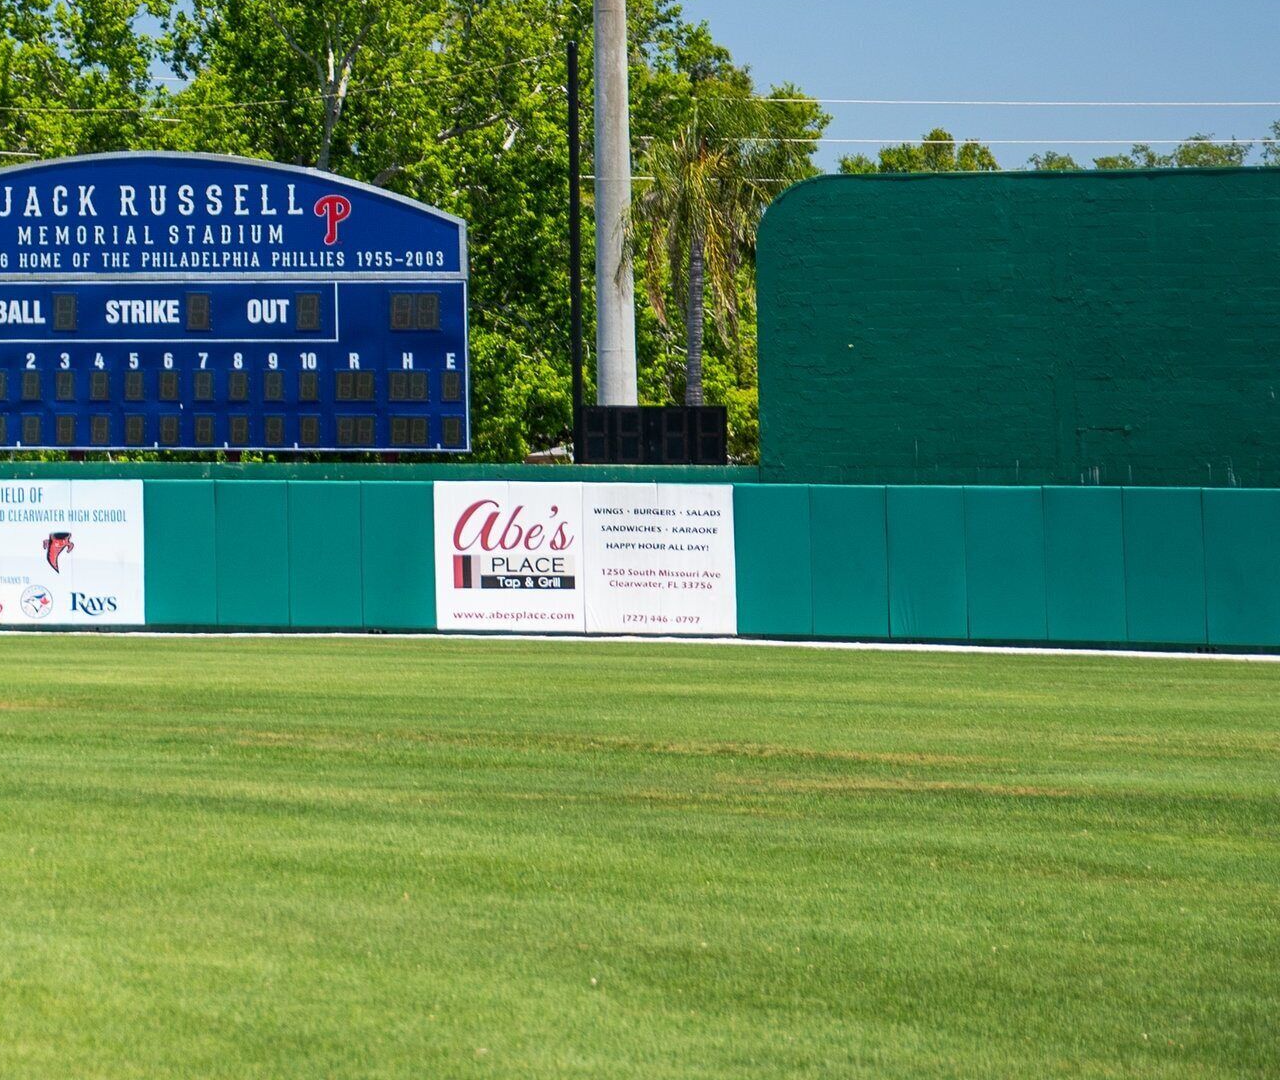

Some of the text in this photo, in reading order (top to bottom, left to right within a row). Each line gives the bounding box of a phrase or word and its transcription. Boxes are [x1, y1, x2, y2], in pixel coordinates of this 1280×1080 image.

[120, 184, 303, 217] RUSSELL
[314, 194, 351, 245] P
[17, 224, 284, 246] MEMORIAL STADIUM
[19, 252, 61, 268] HOME
[72, 252, 91, 268] OF
[102, 252, 130, 268] THE
[142, 251, 260, 267] PHILADELPHIA
[271, 251, 345, 267] PHILLIES
[356, 250, 444, 267] 1955-2003
[105, 299, 180, 324] STRIKE
[247, 299, 290, 324] OUT
[26, 352, 36, 369] 2
[60, 352, 70, 369] 3
[94, 352, 105, 369] 4
[129, 352, 139, 369] 5
[164, 352, 173, 369] 6
[198, 352, 208, 369] 7
[233, 352, 243, 369] 8
[268, 352, 278, 369] 9
[299, 352, 317, 369] 10
[349, 352, 360, 369] R
[402, 352, 413, 369] H
[446, 352, 456, 369] E
[29, 487, 44, 503] OF
[8, 509, 65, 522] CLEARWATER
[68, 509, 90, 522] HIGH
[92, 509, 126, 522] SCHOOL
[593, 507, 721, 517] WINGS BURGERS SALADS
[453, 499, 574, 552] Abe's
[601, 525, 718, 534] SANDWICHES KARAOKE
[606, 542, 709, 552] HAPPY HOUR ALL DAY!
[492, 557, 565, 573] PLACE
[601, 568, 721, 579] 1250 South Missouri Ave
[0, 576, 21, 585] THANKS
[496, 576, 561, 589] Tap & Grill
[609, 580, 713, 590] Clearwater, FL 33756
[453, 610, 575, 621] www.abesplace.com
[622, 614, 648, 624] (727)
[650, 615, 668, 623] 446
[676, 616, 700, 624] 0797
